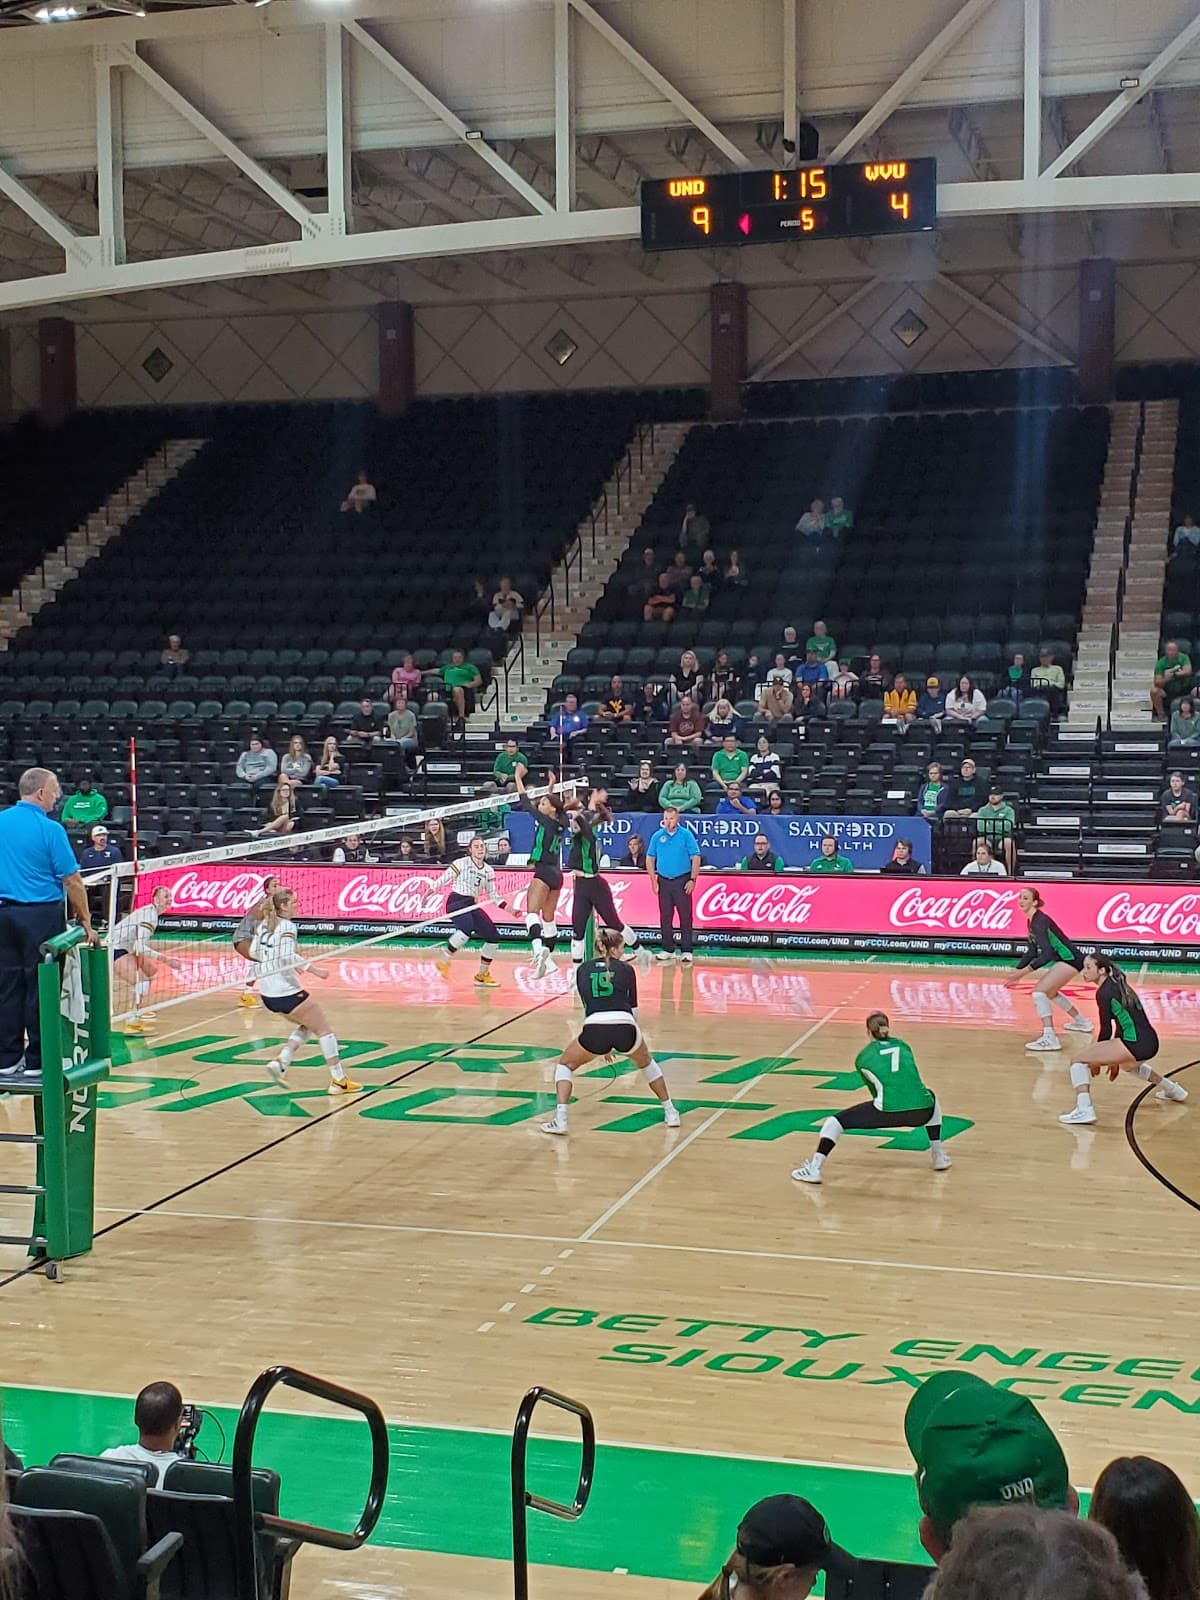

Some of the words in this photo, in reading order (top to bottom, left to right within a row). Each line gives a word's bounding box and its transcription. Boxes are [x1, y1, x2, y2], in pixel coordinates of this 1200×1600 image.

[774, 168, 826, 201] 1:15
[865, 162, 906, 181] WVU
[669, 179, 705, 197] UND
[891, 192, 908, 220] 4
[692, 206, 710, 235] 9
[801, 209, 814, 231] 5
[789, 821, 895, 838] SANFORD
[809, 840, 873, 850] HLTH
[171, 872, 280, 909] Coca-Col
[695, 882, 820, 924] Coca-Cola
[889, 887, 1021, 930] Coca-Cola
[698, 933, 769, 944] myFCCU.com/UND
[776, 936, 850, 946] myFCCU.com/UND
[854, 939, 929, 949] myFCCU.com/UND
[934, 942, 1011, 952] myFCCU.com/UND
[1101, 948, 1182, 958] myFCCU.com/UND
[590, 971, 615, 997] 15
[880, 1046, 900, 1072] 7
[522, 1307, 868, 1349] BETTY
[890, 1339, 1200, 1382] ENGE
[1000, 1477, 1034, 1500] UND
